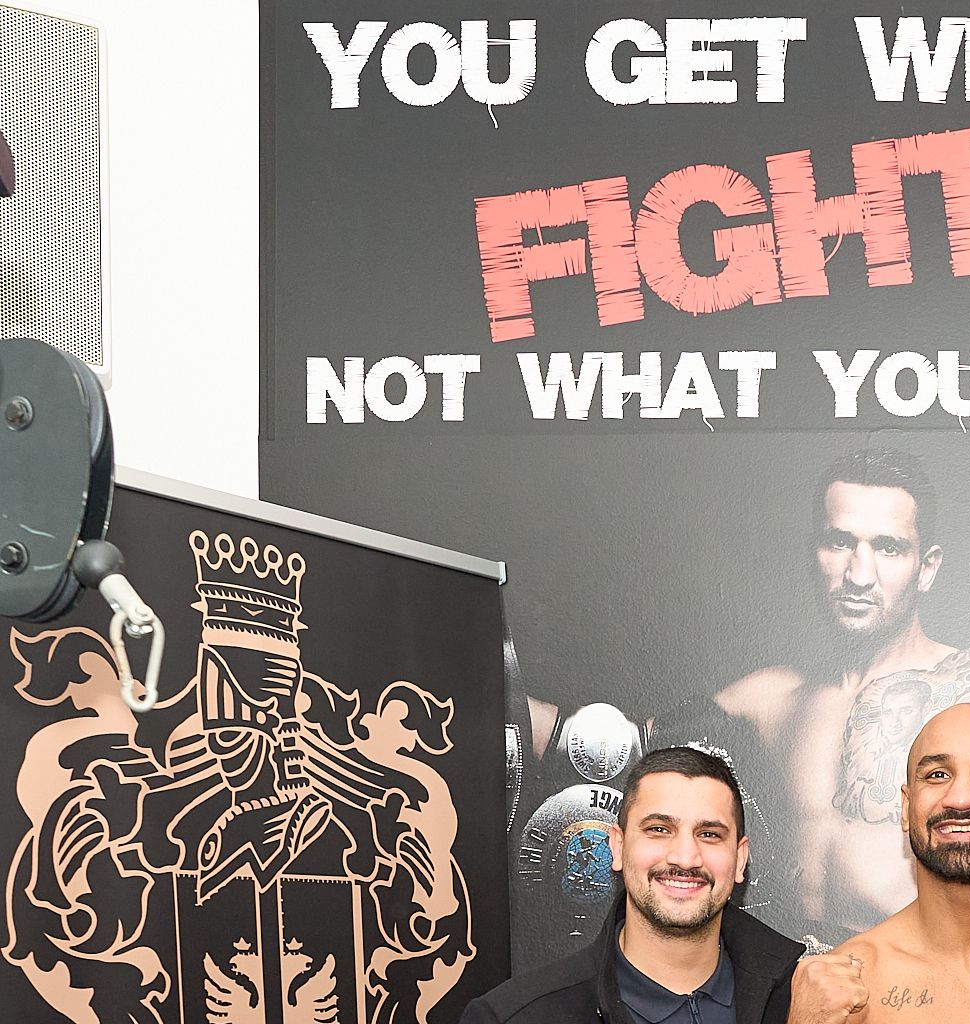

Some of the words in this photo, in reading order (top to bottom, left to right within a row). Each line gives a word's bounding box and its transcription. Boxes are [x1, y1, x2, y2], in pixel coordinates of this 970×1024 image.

[303, 20, 536, 128] YOU
[585, 17, 807, 106] GET
[306, 354, 480, 423] NOT
[517, 351, 777, 431] WHAT
[881, 986, 911, 1011] Life
